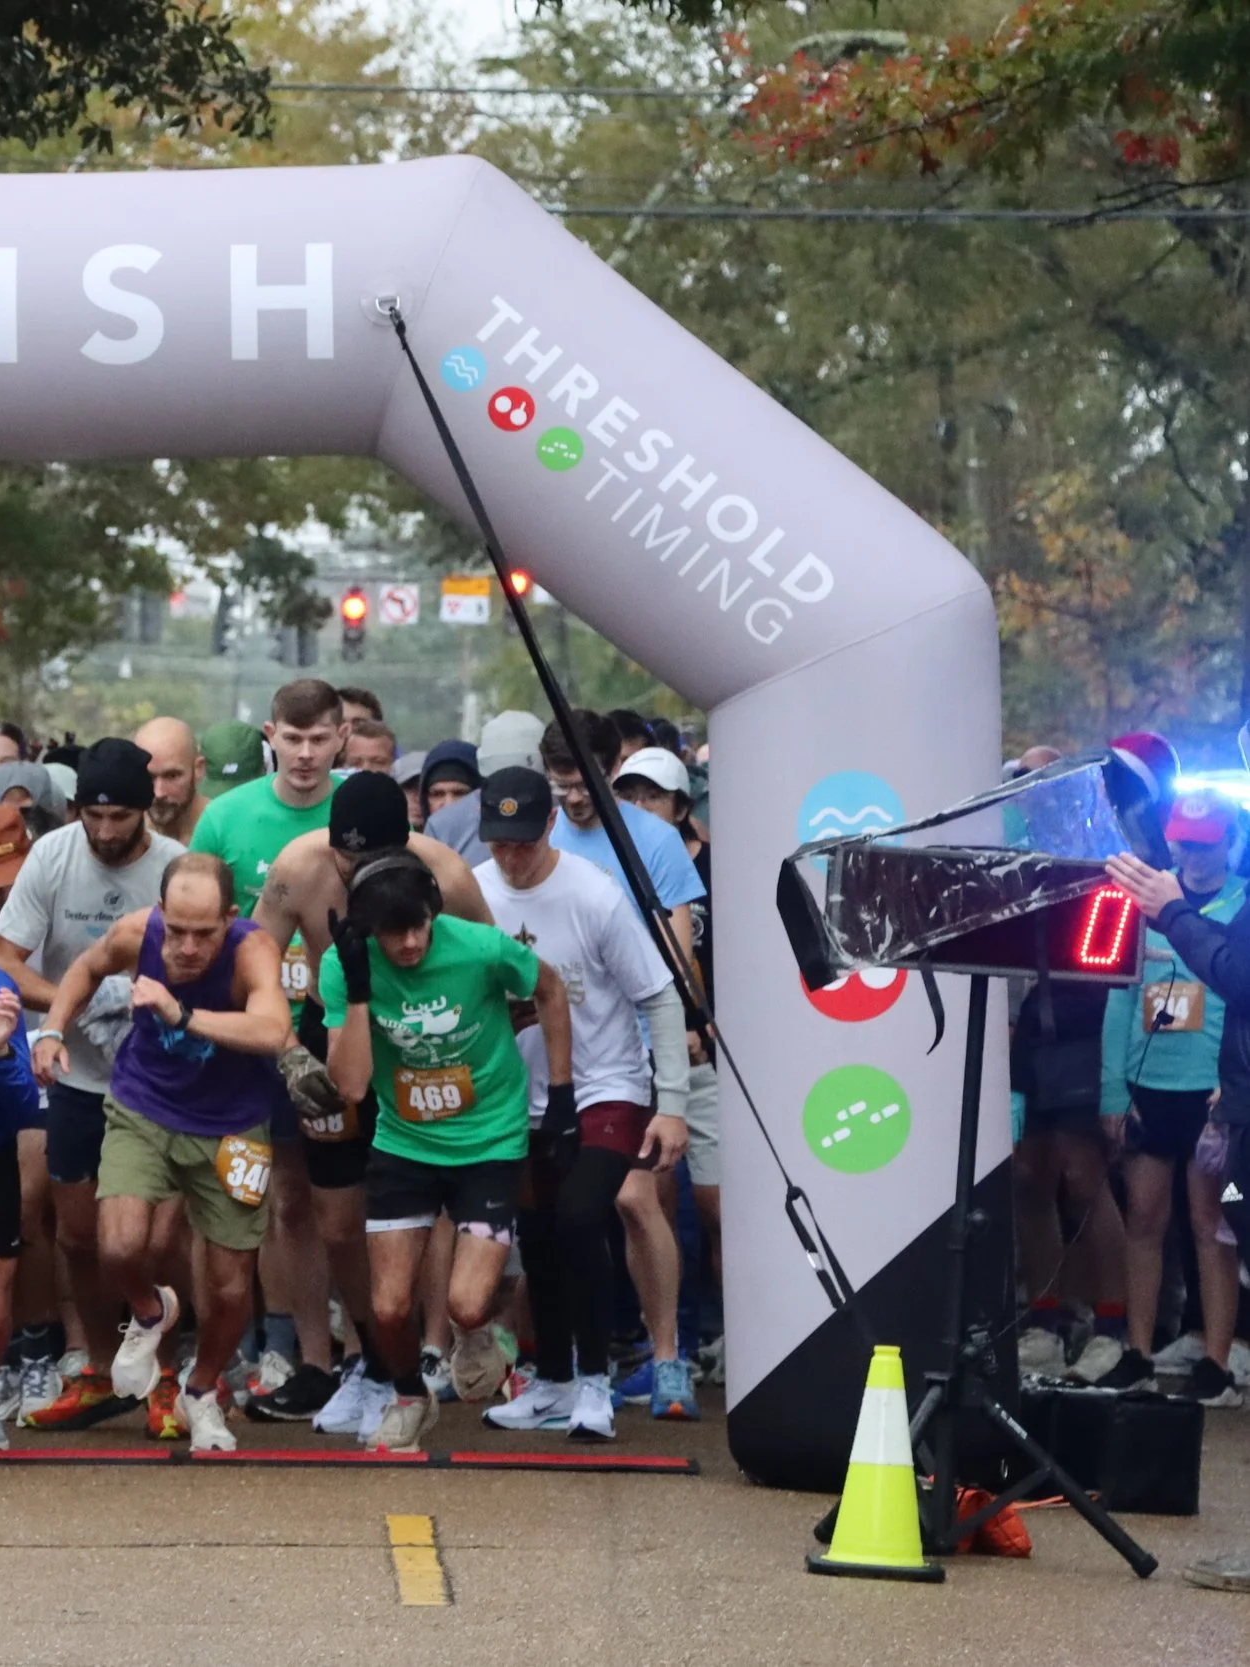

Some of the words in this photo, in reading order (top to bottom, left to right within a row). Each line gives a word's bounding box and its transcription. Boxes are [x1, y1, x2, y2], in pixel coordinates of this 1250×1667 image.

[475, 294, 835, 604] THRESHOLD
[584, 456, 794, 645] TIMING
[1080, 890, 1132, 965] 0
[408, 1083, 462, 1112] 469
